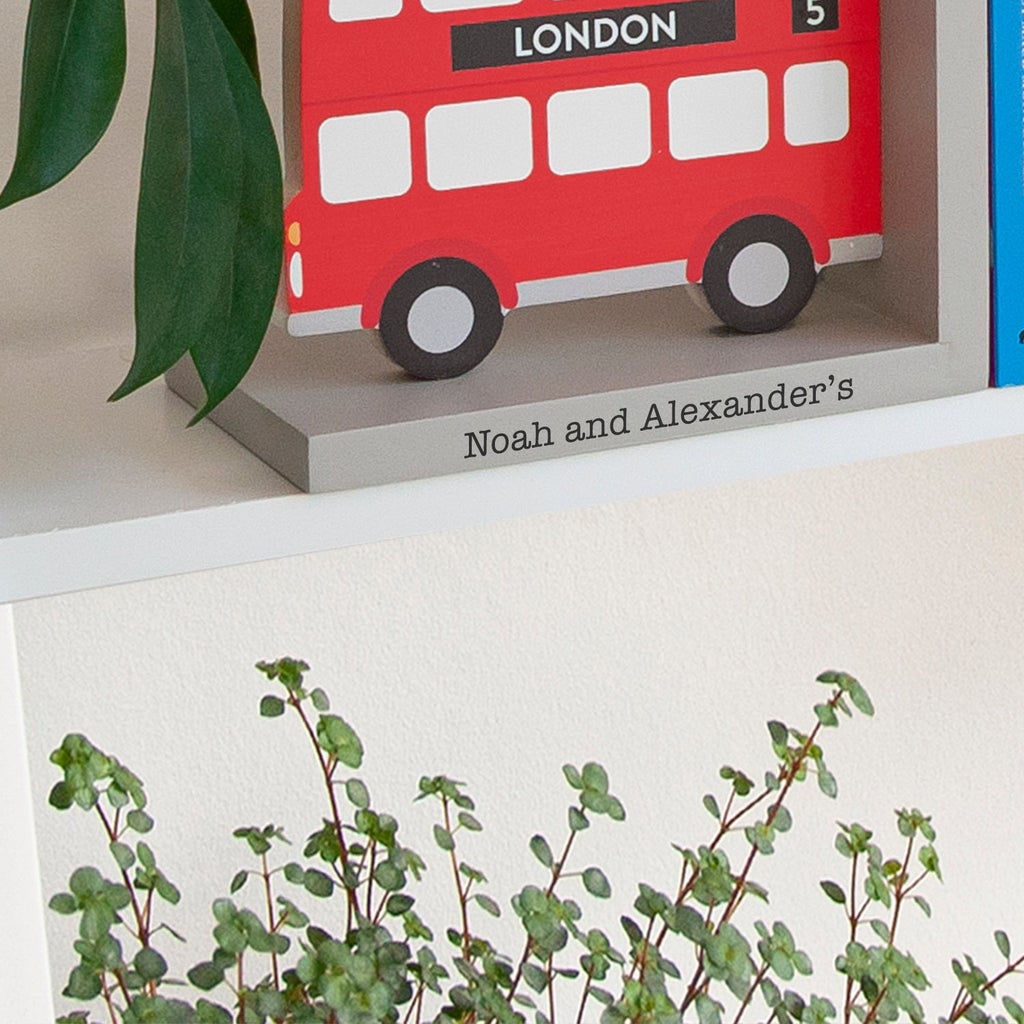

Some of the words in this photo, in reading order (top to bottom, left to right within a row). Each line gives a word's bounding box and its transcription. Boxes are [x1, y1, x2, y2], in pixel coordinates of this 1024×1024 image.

[514, 10, 677, 57] LONDON
[463, 421, 554, 459] Noah
[565, 408, 630, 443] and
